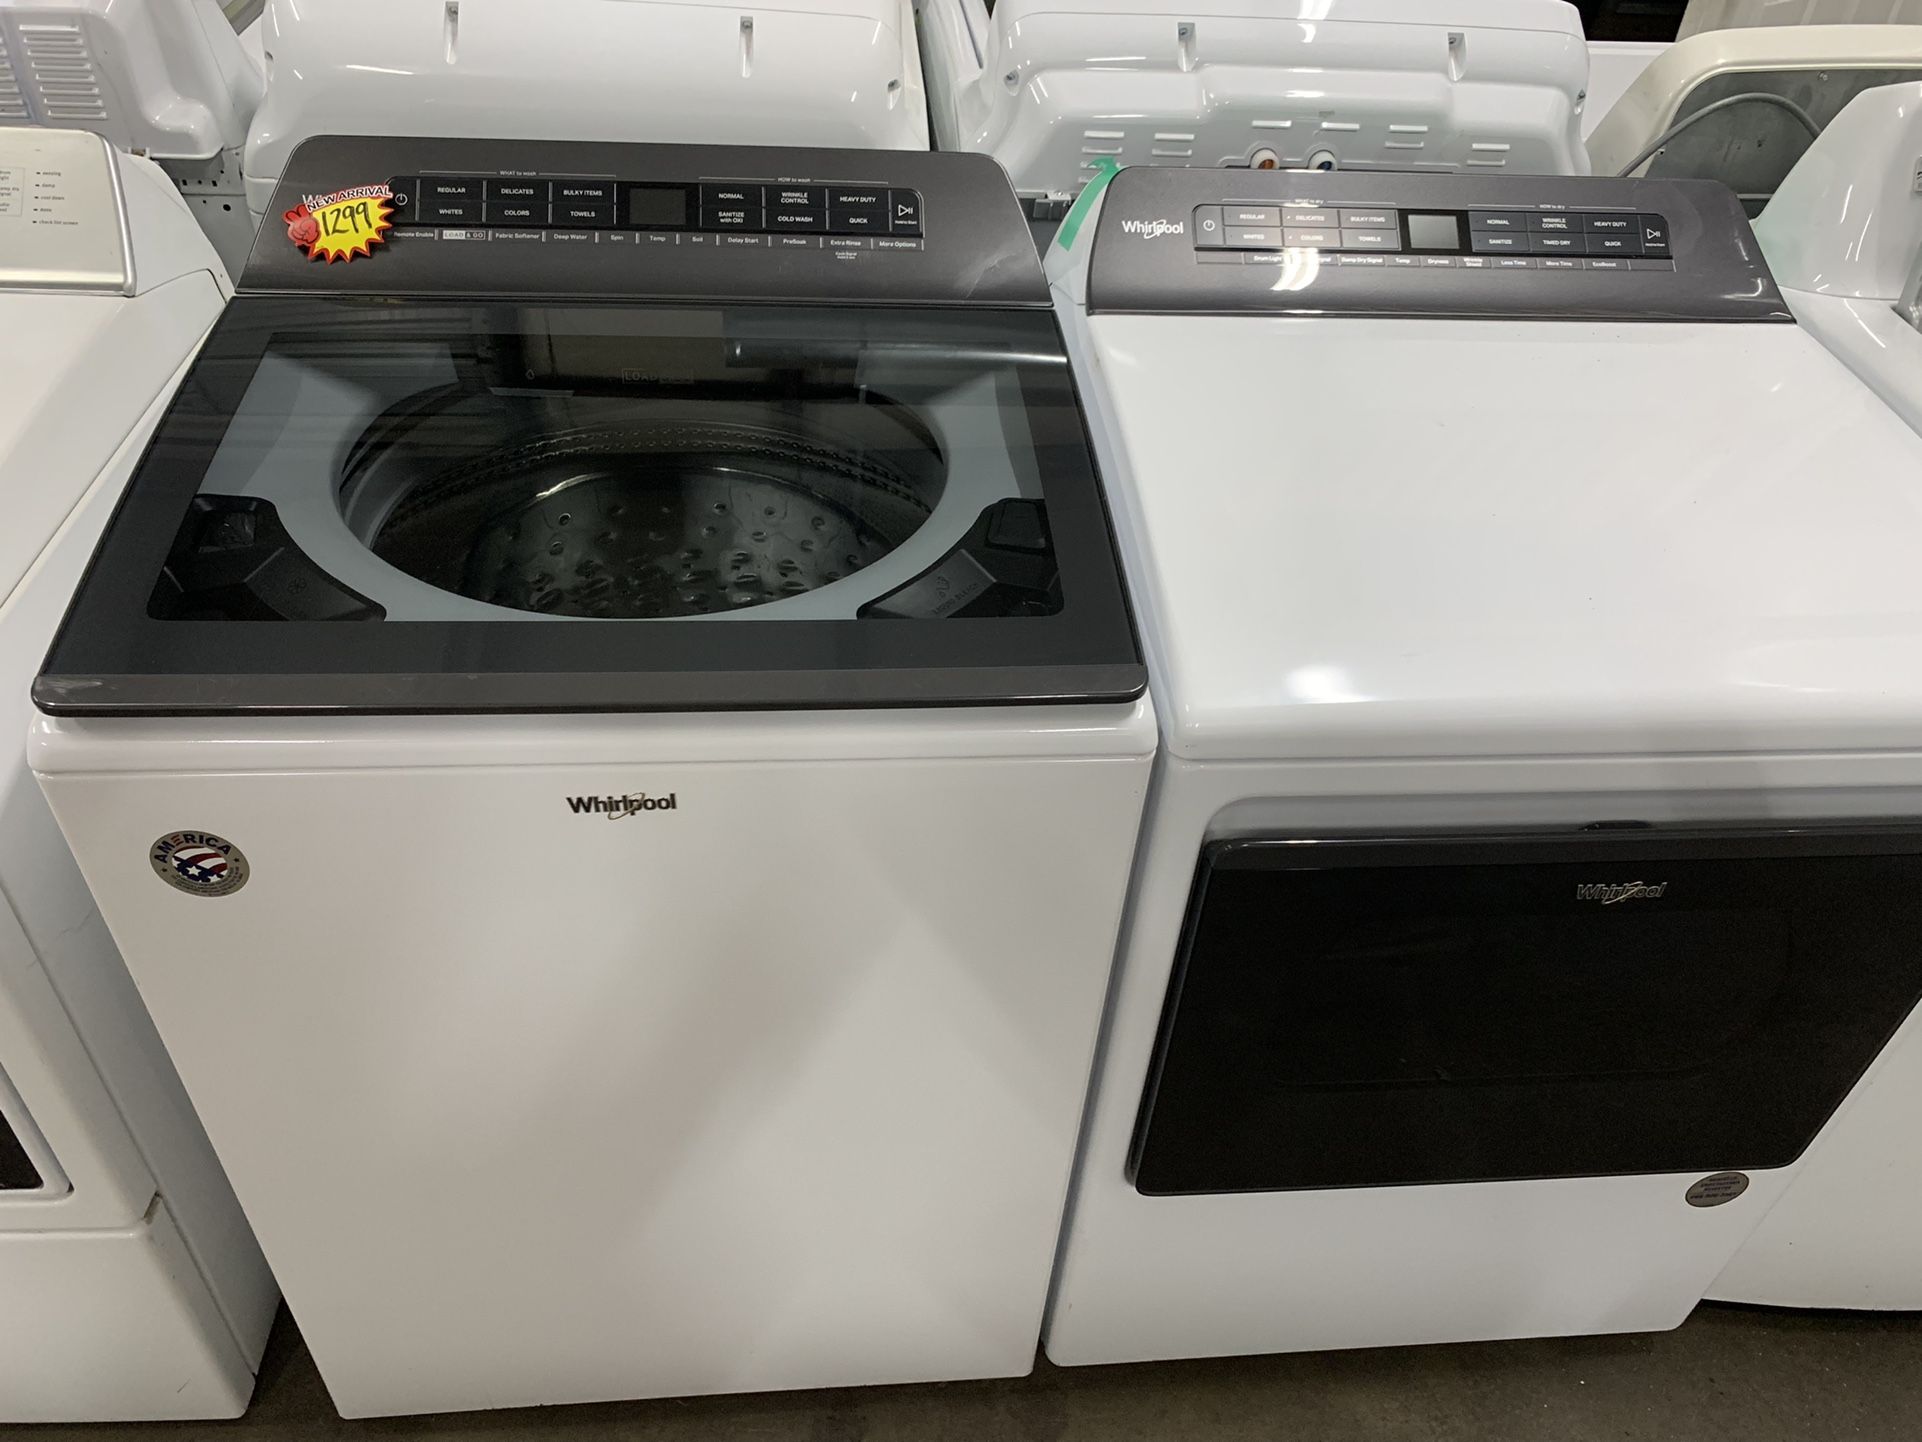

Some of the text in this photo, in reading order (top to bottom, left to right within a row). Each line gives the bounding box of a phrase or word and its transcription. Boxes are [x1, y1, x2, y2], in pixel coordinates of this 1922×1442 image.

[308, 194, 336, 212] NEW
[339, 186, 392, 200] ARRIVAL
[322, 202, 372, 237] 1299
[1122, 220, 1184, 239] Whirlpool
[566, 792, 678, 819] Whirlpool
[154, 834, 232, 864] AMERICA
[1577, 881, 1668, 904] Whirlpool
